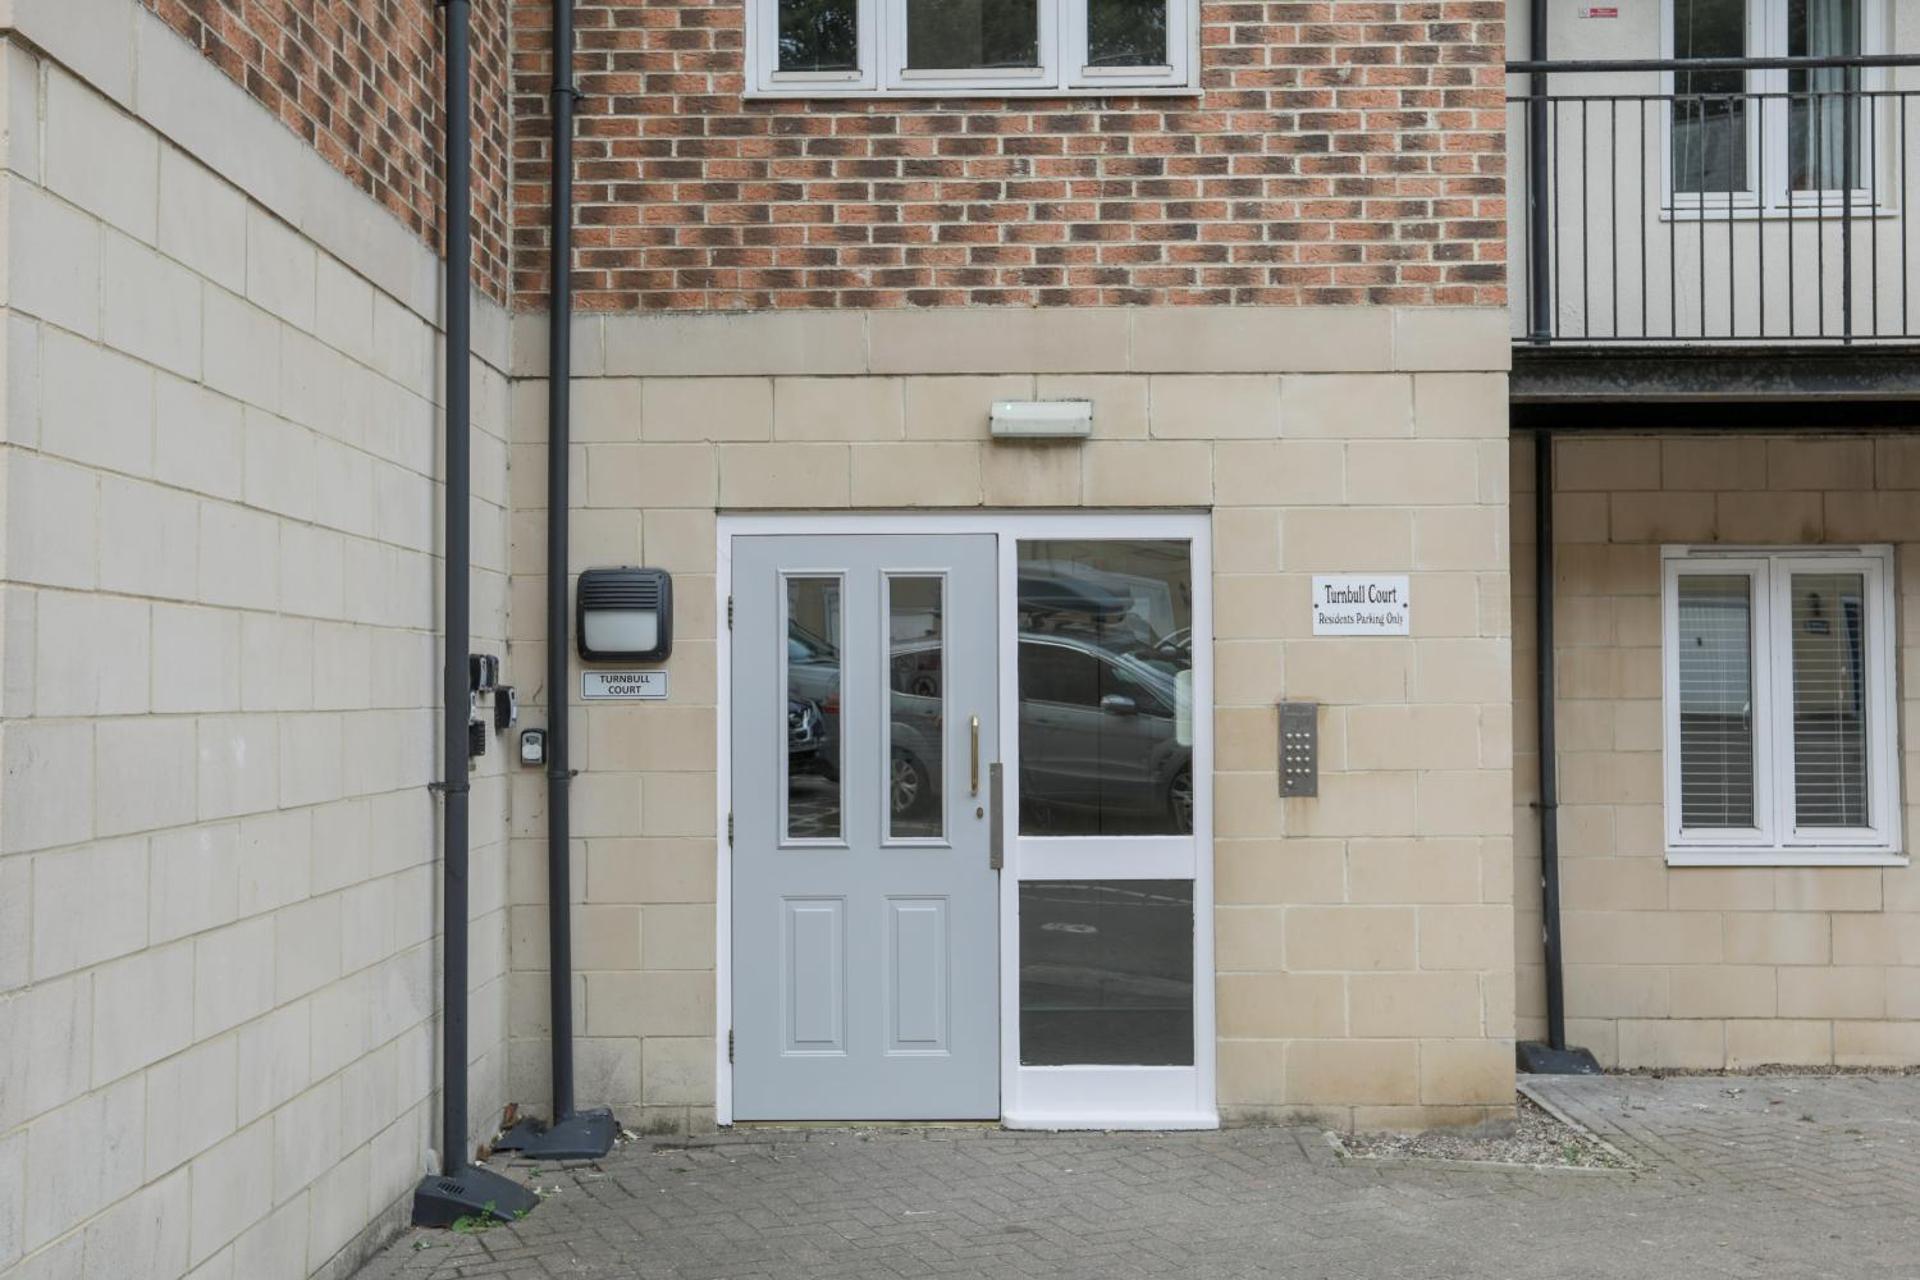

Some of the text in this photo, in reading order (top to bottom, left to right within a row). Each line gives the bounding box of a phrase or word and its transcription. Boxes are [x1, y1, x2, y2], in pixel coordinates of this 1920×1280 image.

[1324, 584, 1397, 604] Turnbull Court
[1318, 612, 1403, 627] Residents Parking Only
[600, 675, 651, 683] TURNBULL
[608, 685, 642, 695] COURT
